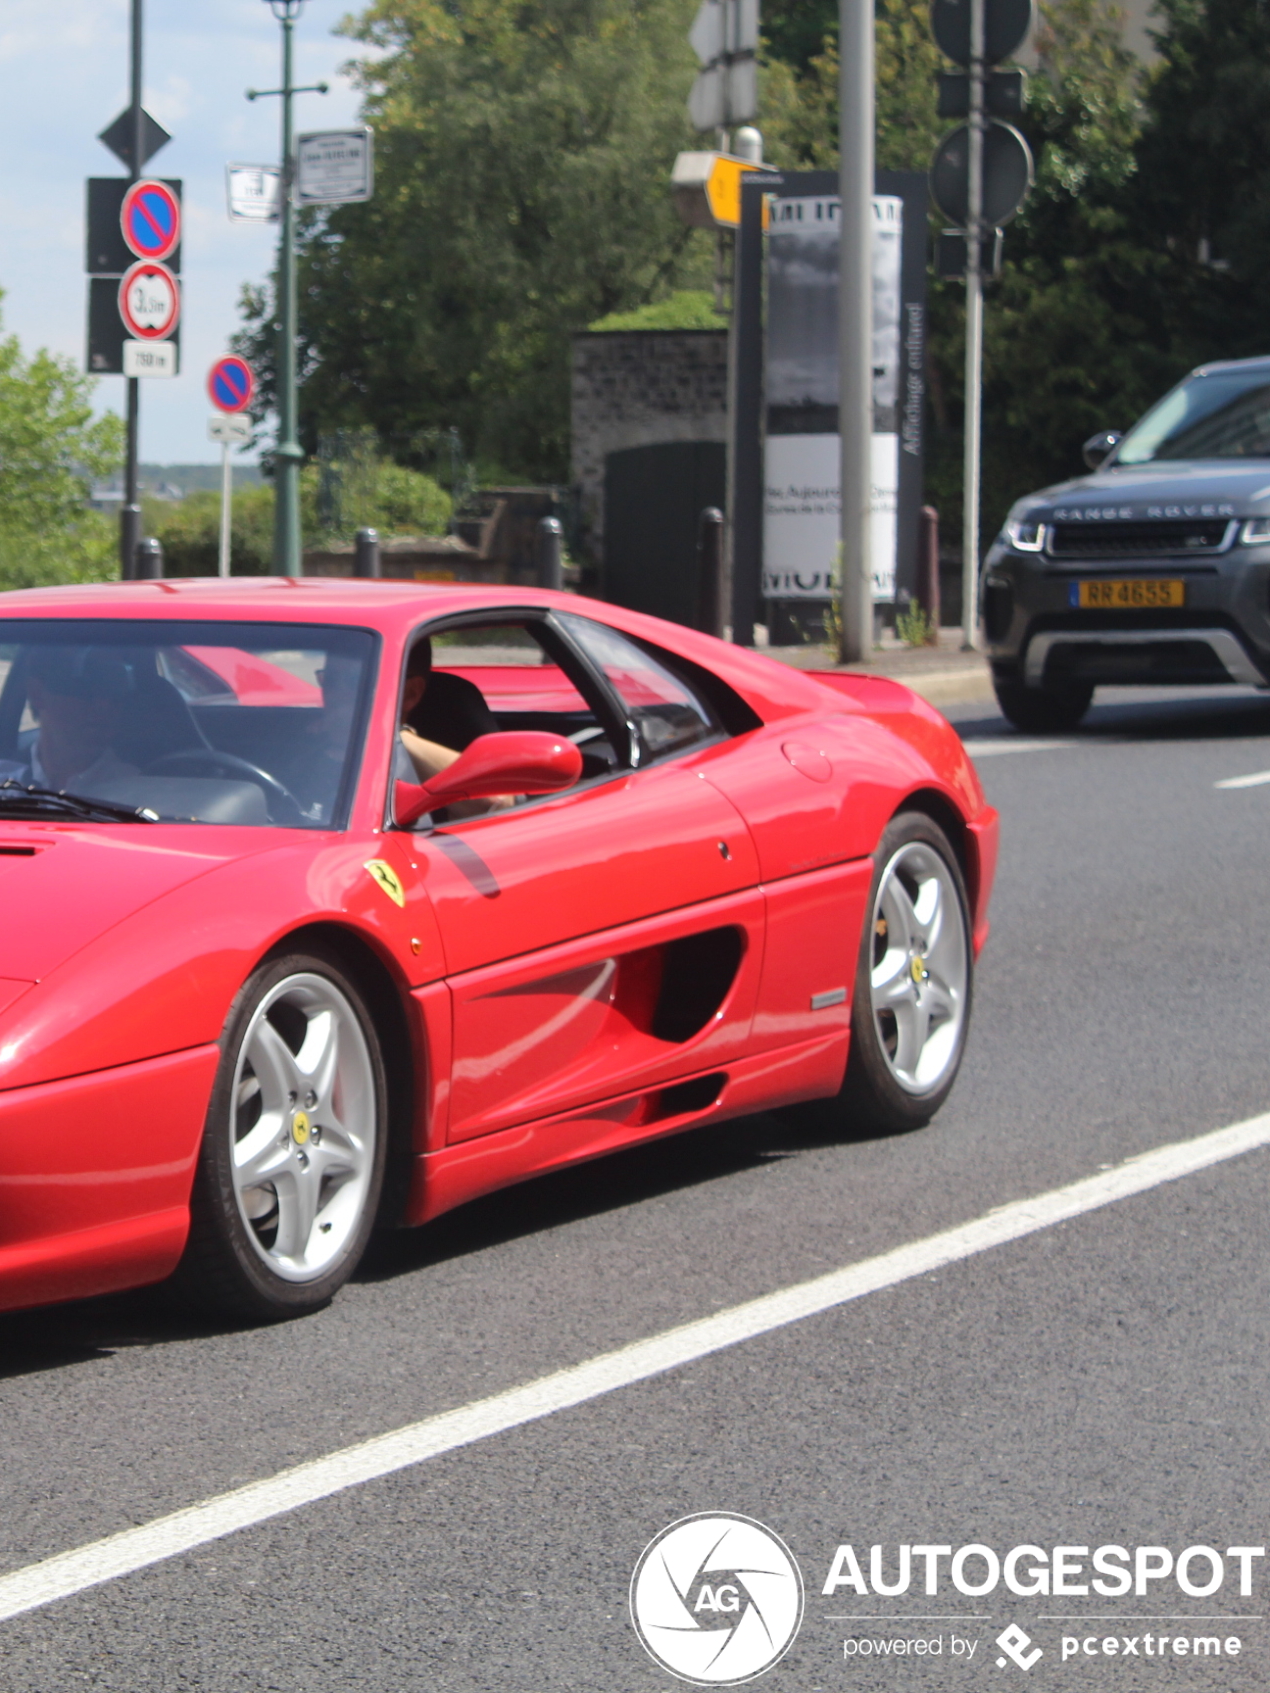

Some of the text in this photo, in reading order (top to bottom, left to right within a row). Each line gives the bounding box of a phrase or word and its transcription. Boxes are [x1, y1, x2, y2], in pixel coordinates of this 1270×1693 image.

[1053, 504, 1234, 520] RANGE ROVER
[1088, 581, 1171, 604] RR 4655
